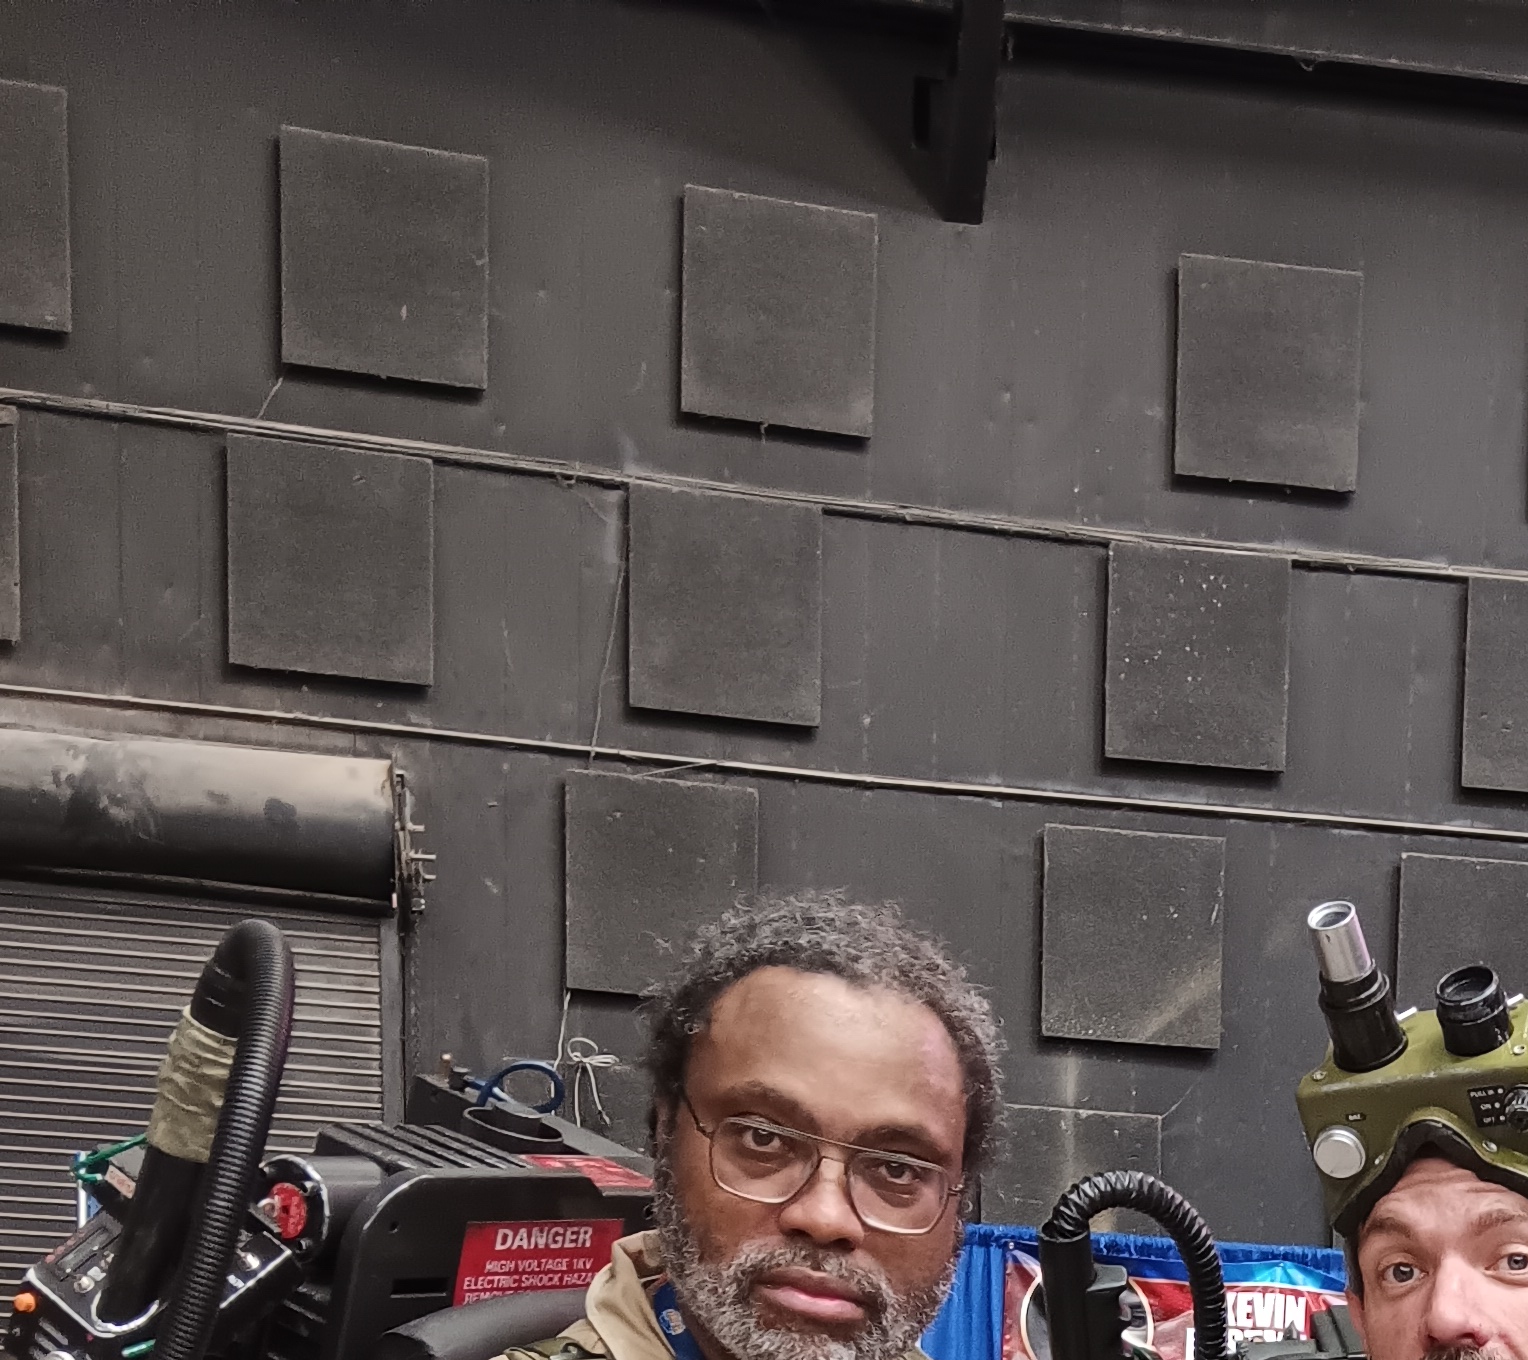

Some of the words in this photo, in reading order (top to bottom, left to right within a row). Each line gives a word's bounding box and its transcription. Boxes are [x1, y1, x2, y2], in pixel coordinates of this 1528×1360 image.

[495, 1226, 593, 1250] DANGER
[485, 1259, 514, 1273] HIGH
[518, 1258, 569, 1271] VOLTAGE
[463, 1275, 518, 1290] ELECTRIC
[521, 1273, 560, 1287] SHOCK
[563, 1272, 598, 1285] HAZA
